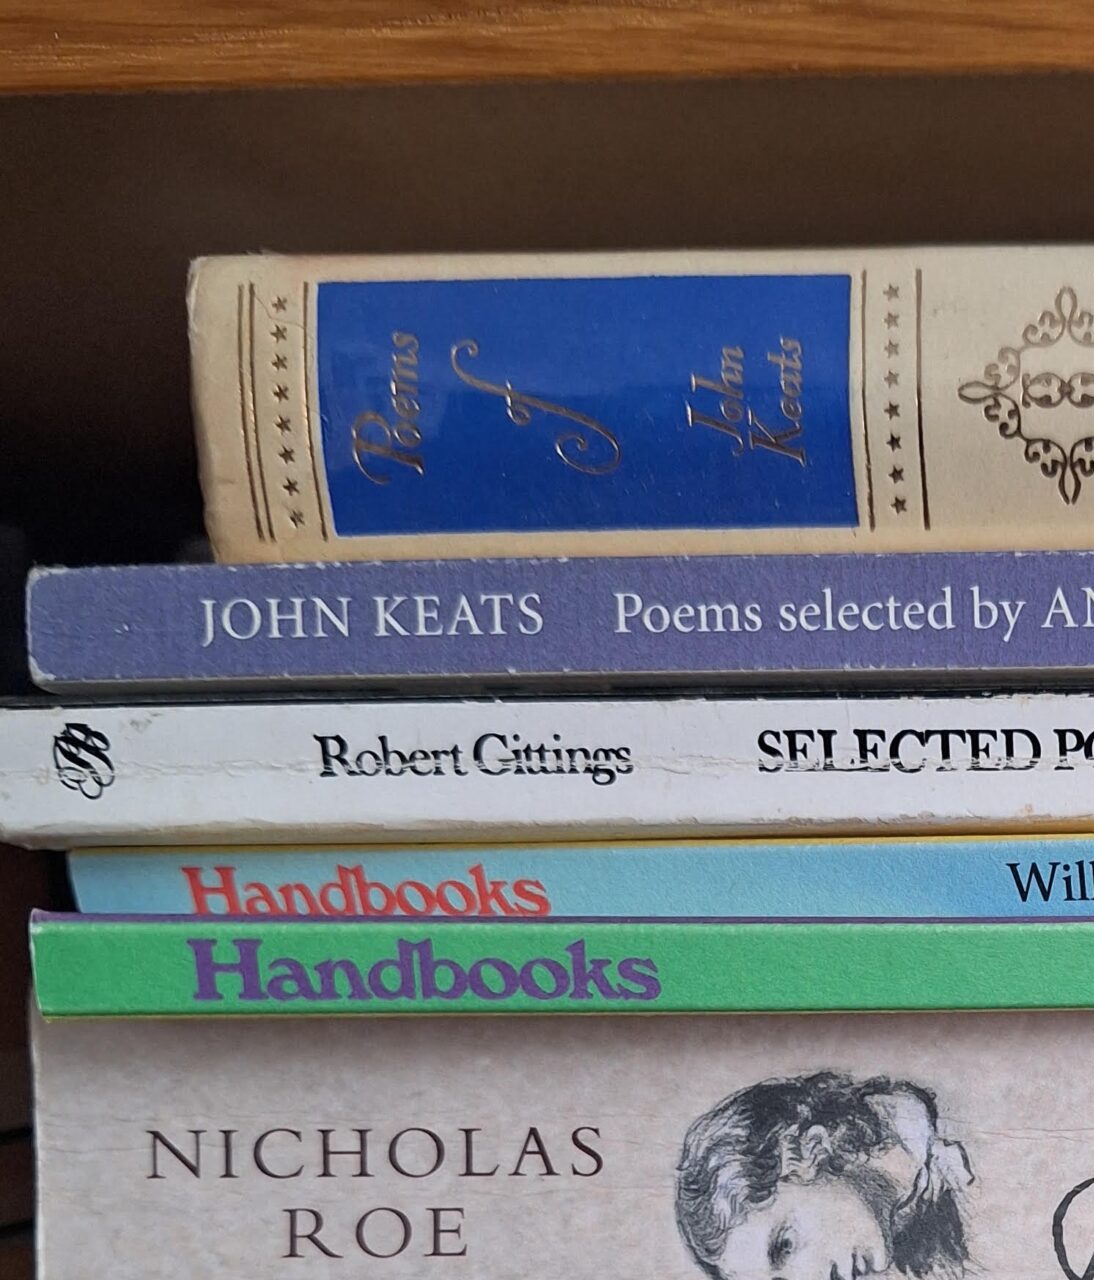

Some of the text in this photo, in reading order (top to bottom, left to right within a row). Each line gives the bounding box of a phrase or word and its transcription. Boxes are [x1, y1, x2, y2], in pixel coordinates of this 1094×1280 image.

[352, 331, 424, 485] Poems
[686, 345, 743, 456] John
[748, 335, 807, 467] Keats
[201, 598, 352, 647] JOHN
[374, 593, 544, 637] KEATS
[614, 592, 762, 633] Poems
[779, 586, 955, 632] selected
[969, 585, 1026, 642] by
[313, 732, 634, 786] Robert Gittings
[756, 727, 1042, 774] SELECTED
[180, 863, 553, 917] Handbooks
[186, 937, 663, 1001] Handbooks
[146, 1125, 604, 1180] NICHOLAS
[281, 1206, 468, 1259] ROE
